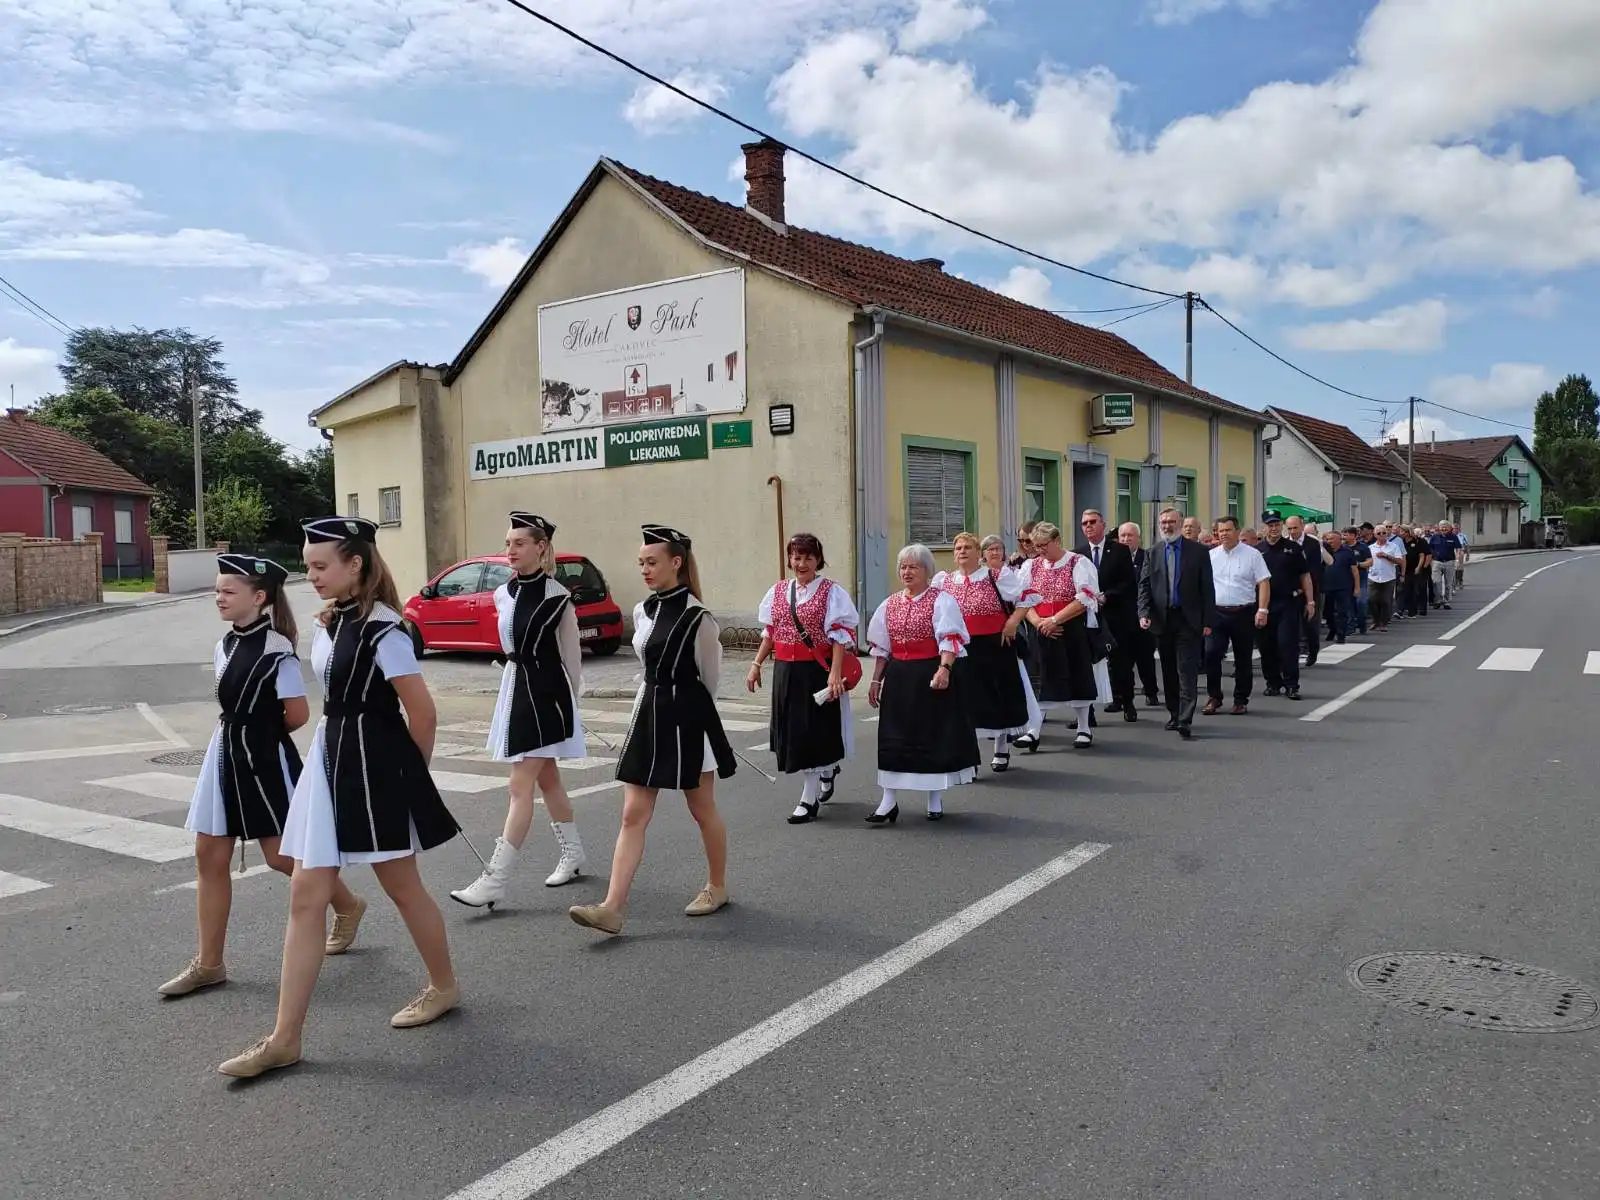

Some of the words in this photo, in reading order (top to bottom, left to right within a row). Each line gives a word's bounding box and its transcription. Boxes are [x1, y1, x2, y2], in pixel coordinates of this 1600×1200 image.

[563, 313, 618, 351] Hotel
[650, 297, 703, 335] Park
[628, 385, 637, 395] 15
[610, 424, 701, 445] POLJOPRIVREDNA
[475, 436, 598, 475] AgroMARTIN
[630, 445, 681, 461] LJEKARNA
